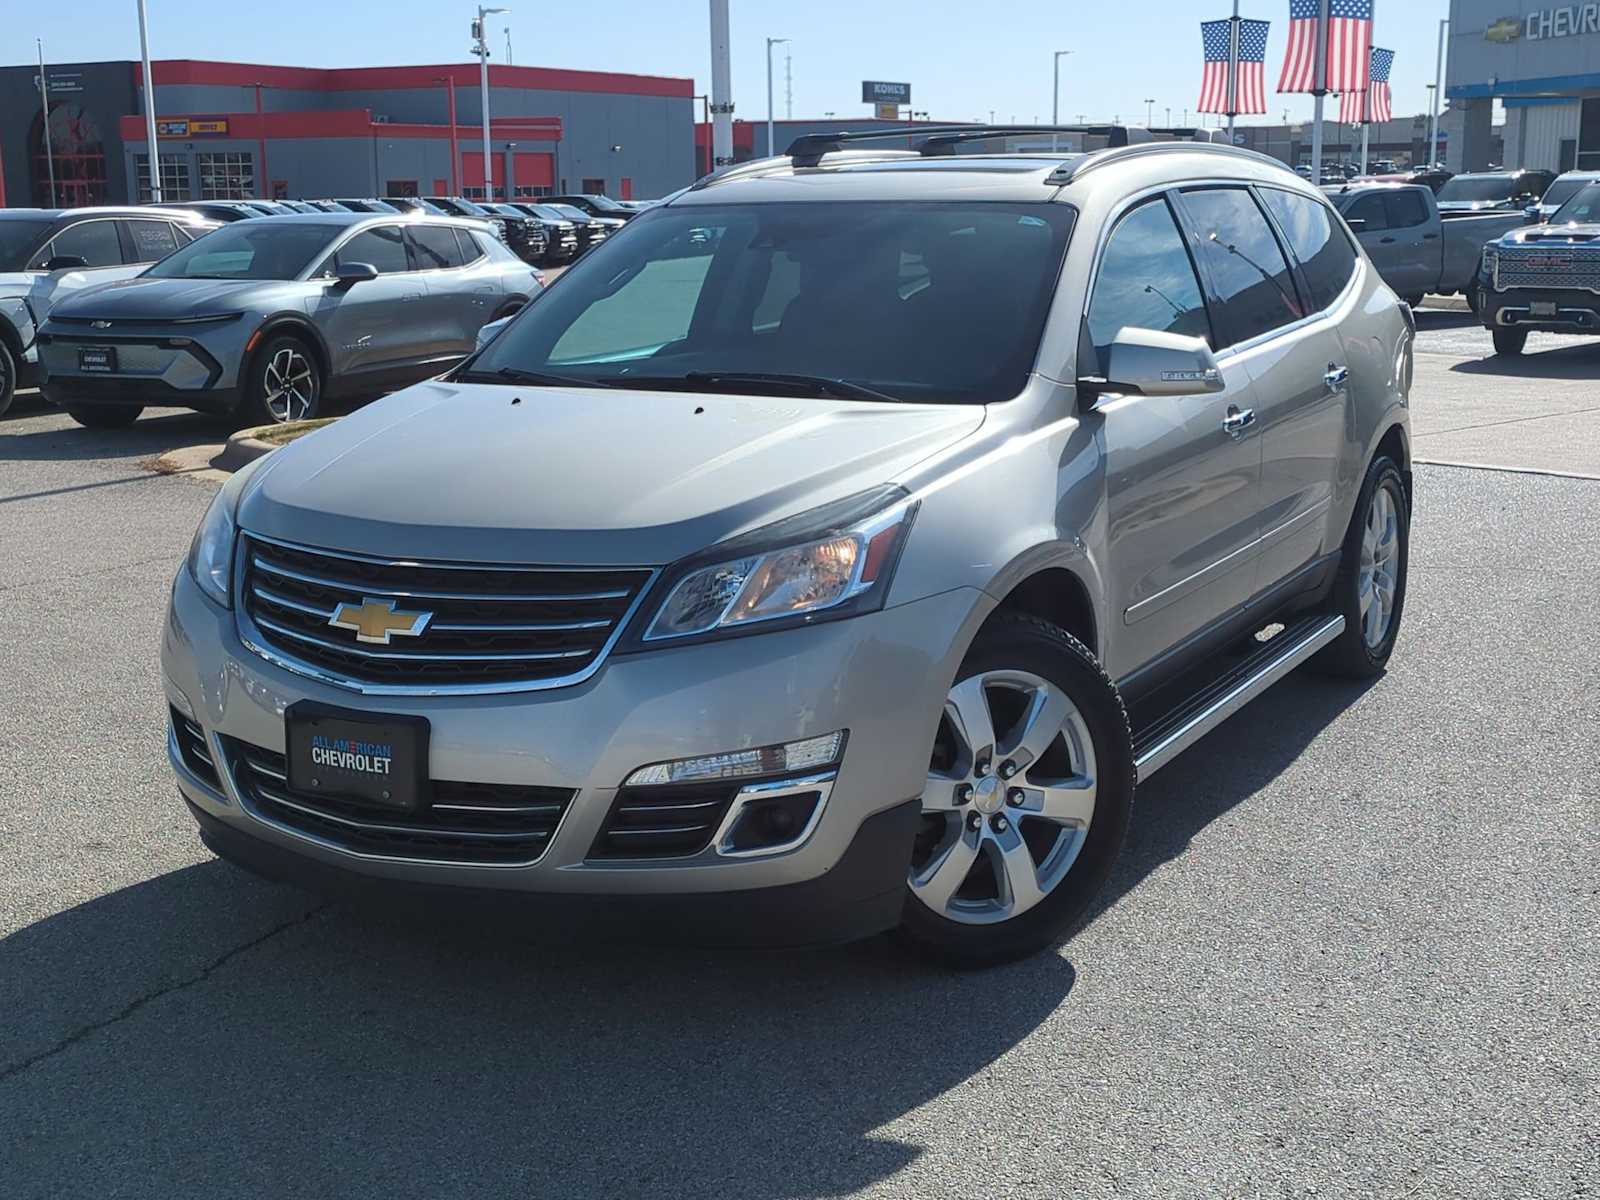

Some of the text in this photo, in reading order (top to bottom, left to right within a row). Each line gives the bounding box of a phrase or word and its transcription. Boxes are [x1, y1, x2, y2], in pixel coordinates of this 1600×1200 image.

[1526, 3, 1600, 40] CHEVR
[312, 736, 391, 757] ALL AMERICAN
[312, 747, 392, 774] CHEVROLET
